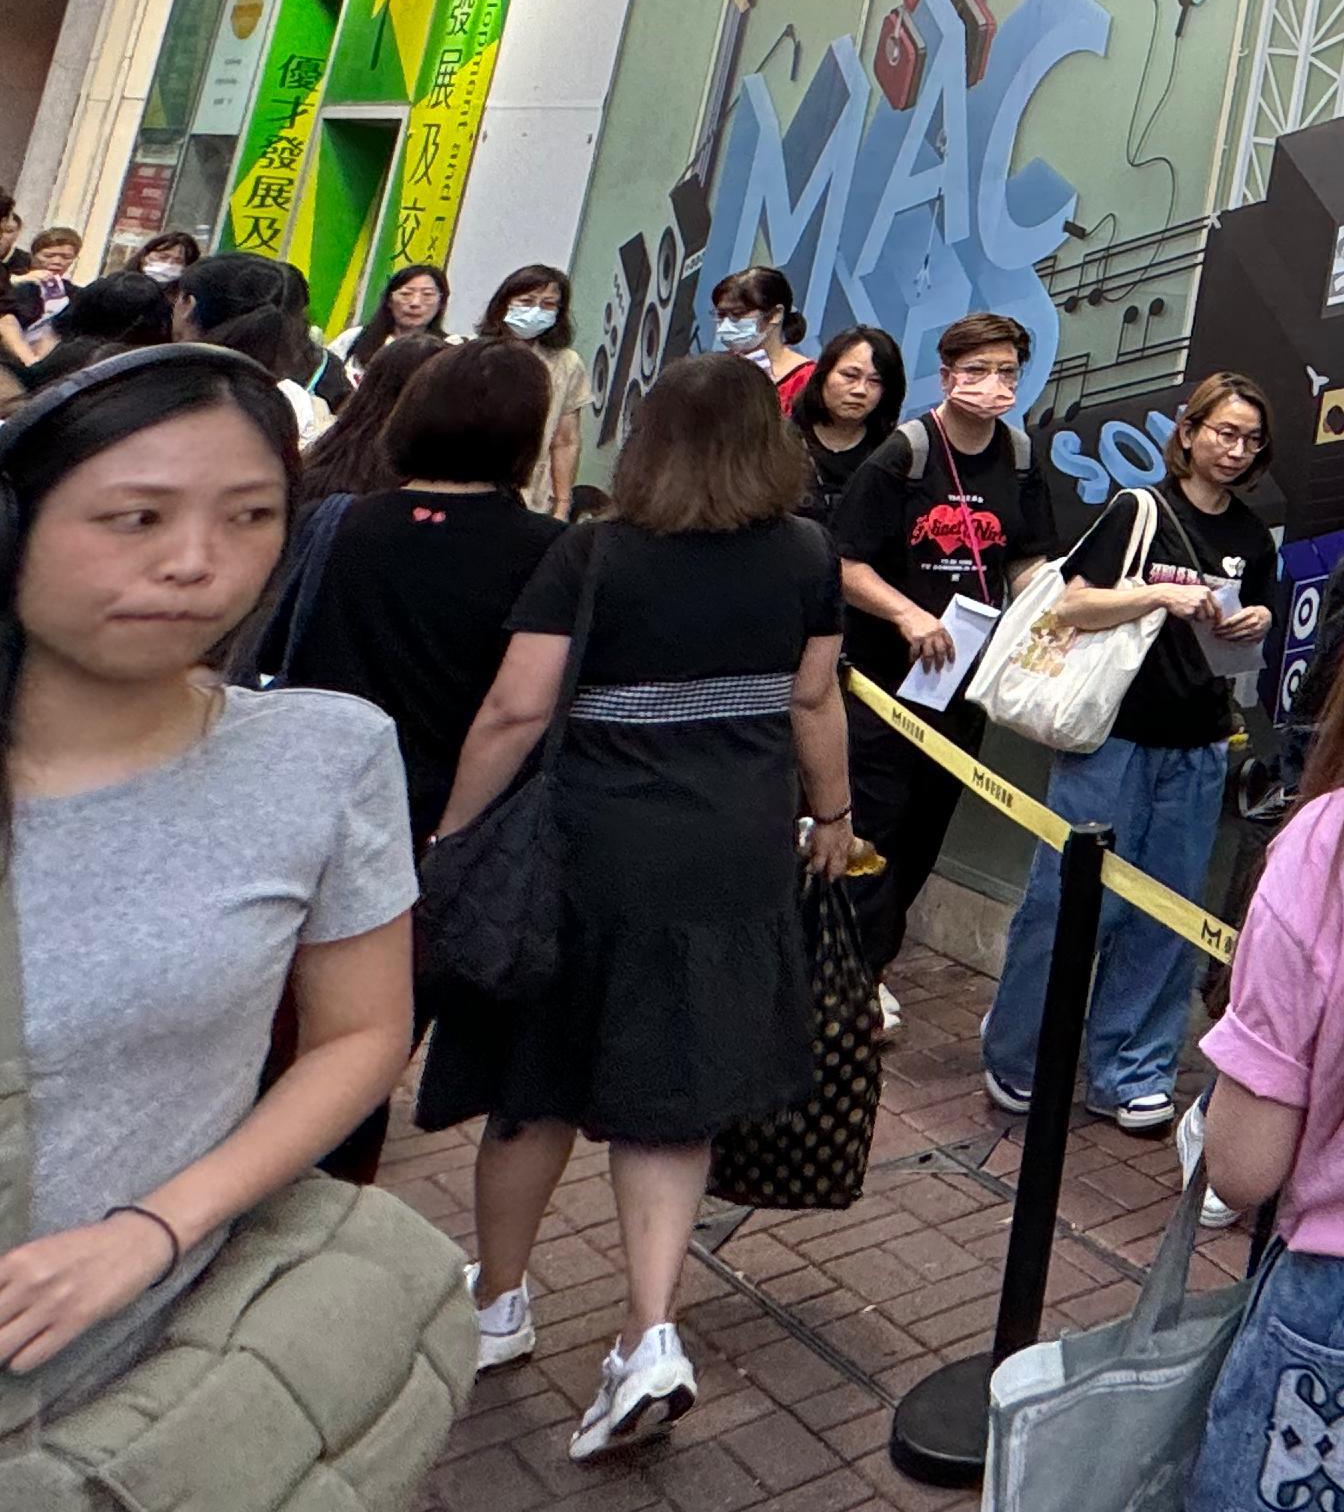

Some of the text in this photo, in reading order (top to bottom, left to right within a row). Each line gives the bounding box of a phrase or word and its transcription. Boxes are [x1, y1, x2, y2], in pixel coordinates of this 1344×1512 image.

[235, 53, 326, 253] 優才發展及
[1050, 410, 1190, 505] SO
